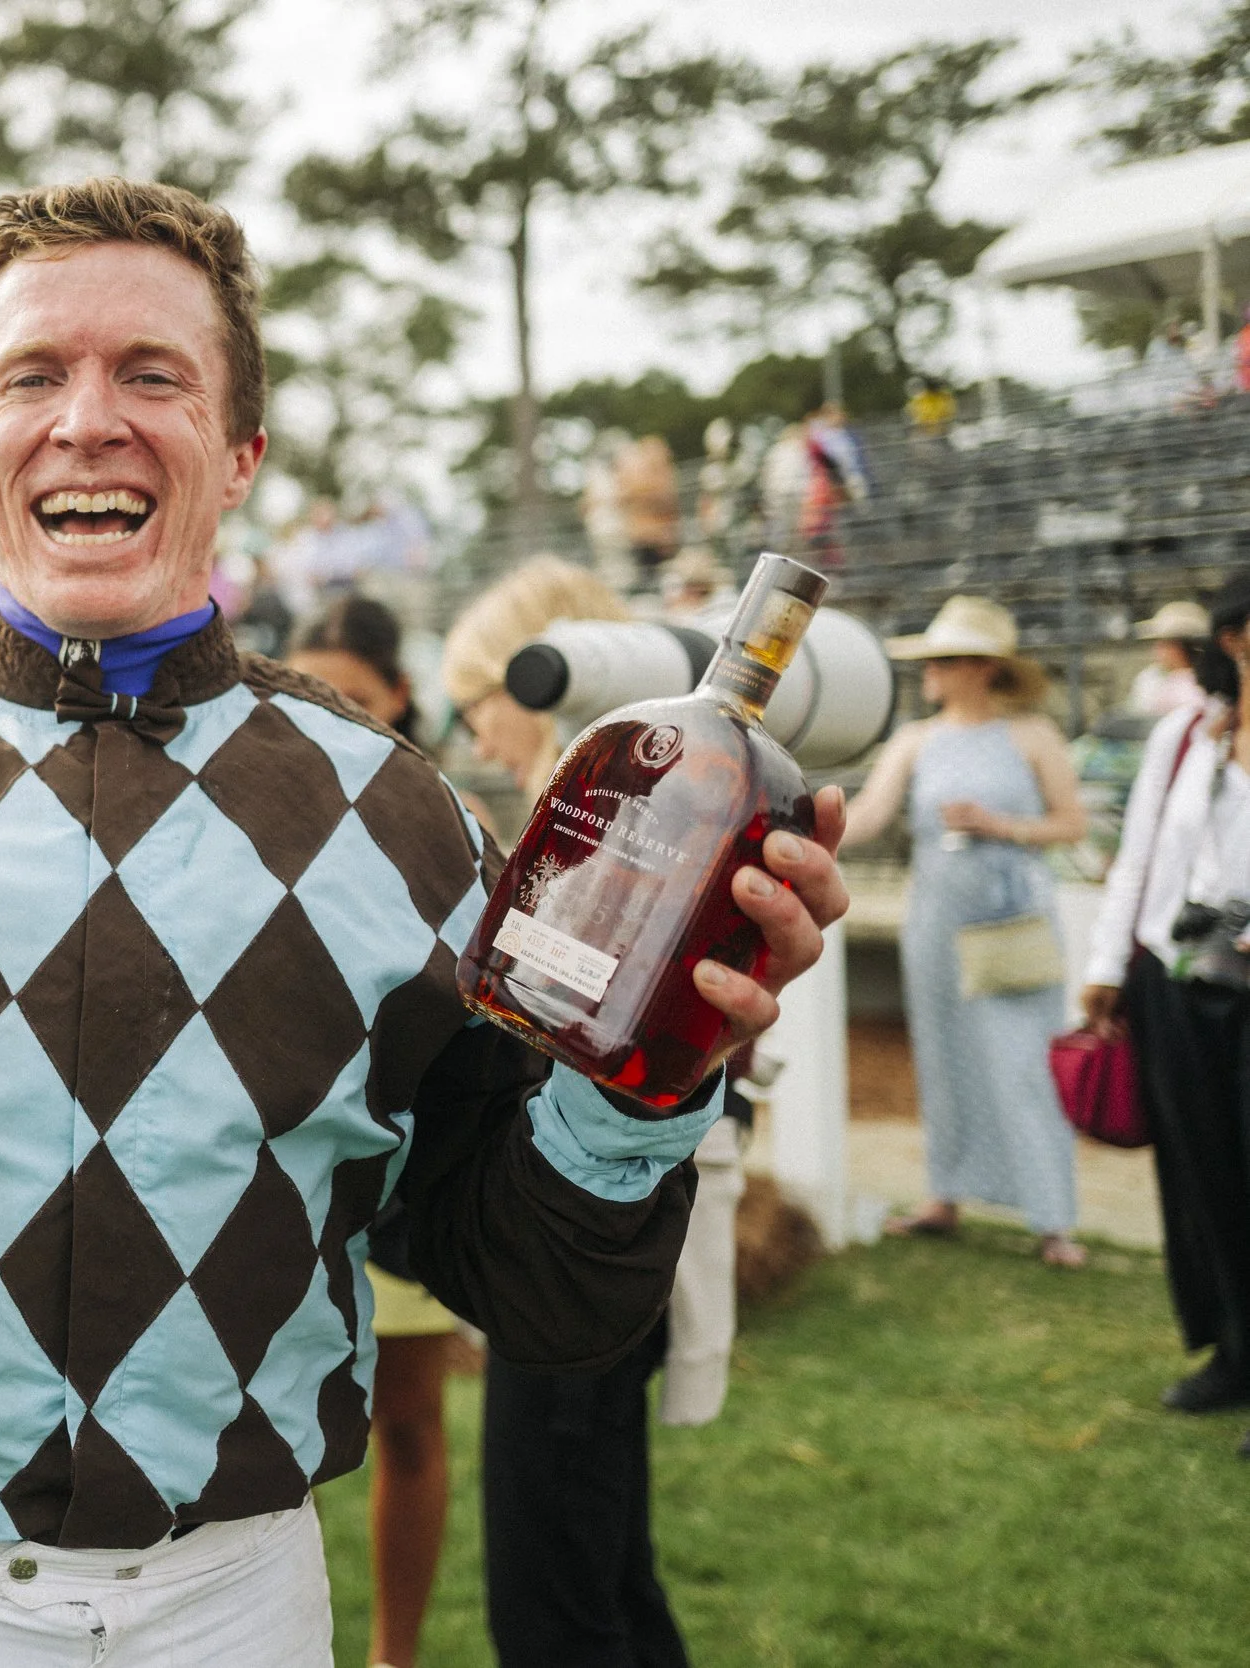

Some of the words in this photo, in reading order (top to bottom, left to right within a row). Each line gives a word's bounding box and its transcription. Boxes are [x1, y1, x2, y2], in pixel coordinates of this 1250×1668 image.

[550, 796, 614, 832] WOODFORD
[553, 822, 578, 838] KENTUCKY
[576, 832, 602, 849] STRAIGHT
